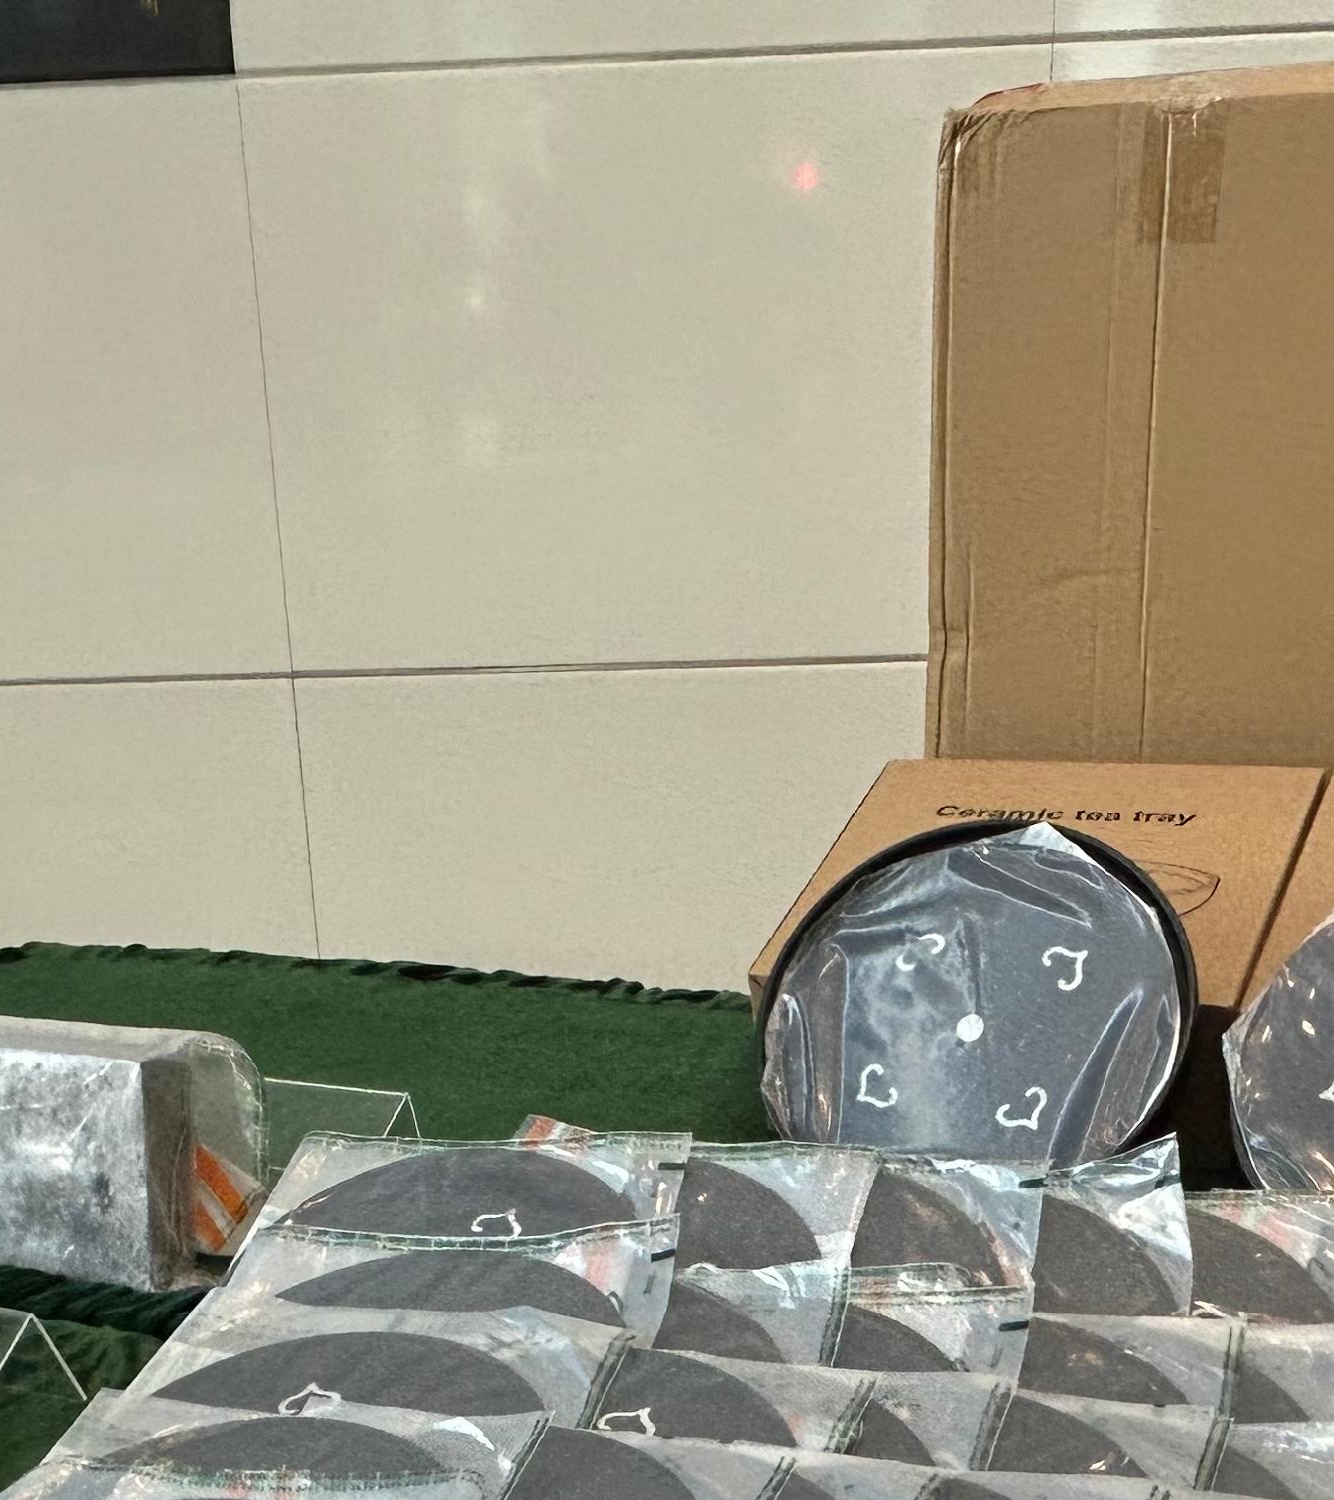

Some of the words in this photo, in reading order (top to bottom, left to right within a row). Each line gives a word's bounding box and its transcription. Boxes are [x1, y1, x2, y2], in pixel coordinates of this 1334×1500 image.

[936, 804, 1065, 822] Ceramic
[1075, 807, 1121, 822] tea
[1132, 809, 1197, 827] tray
